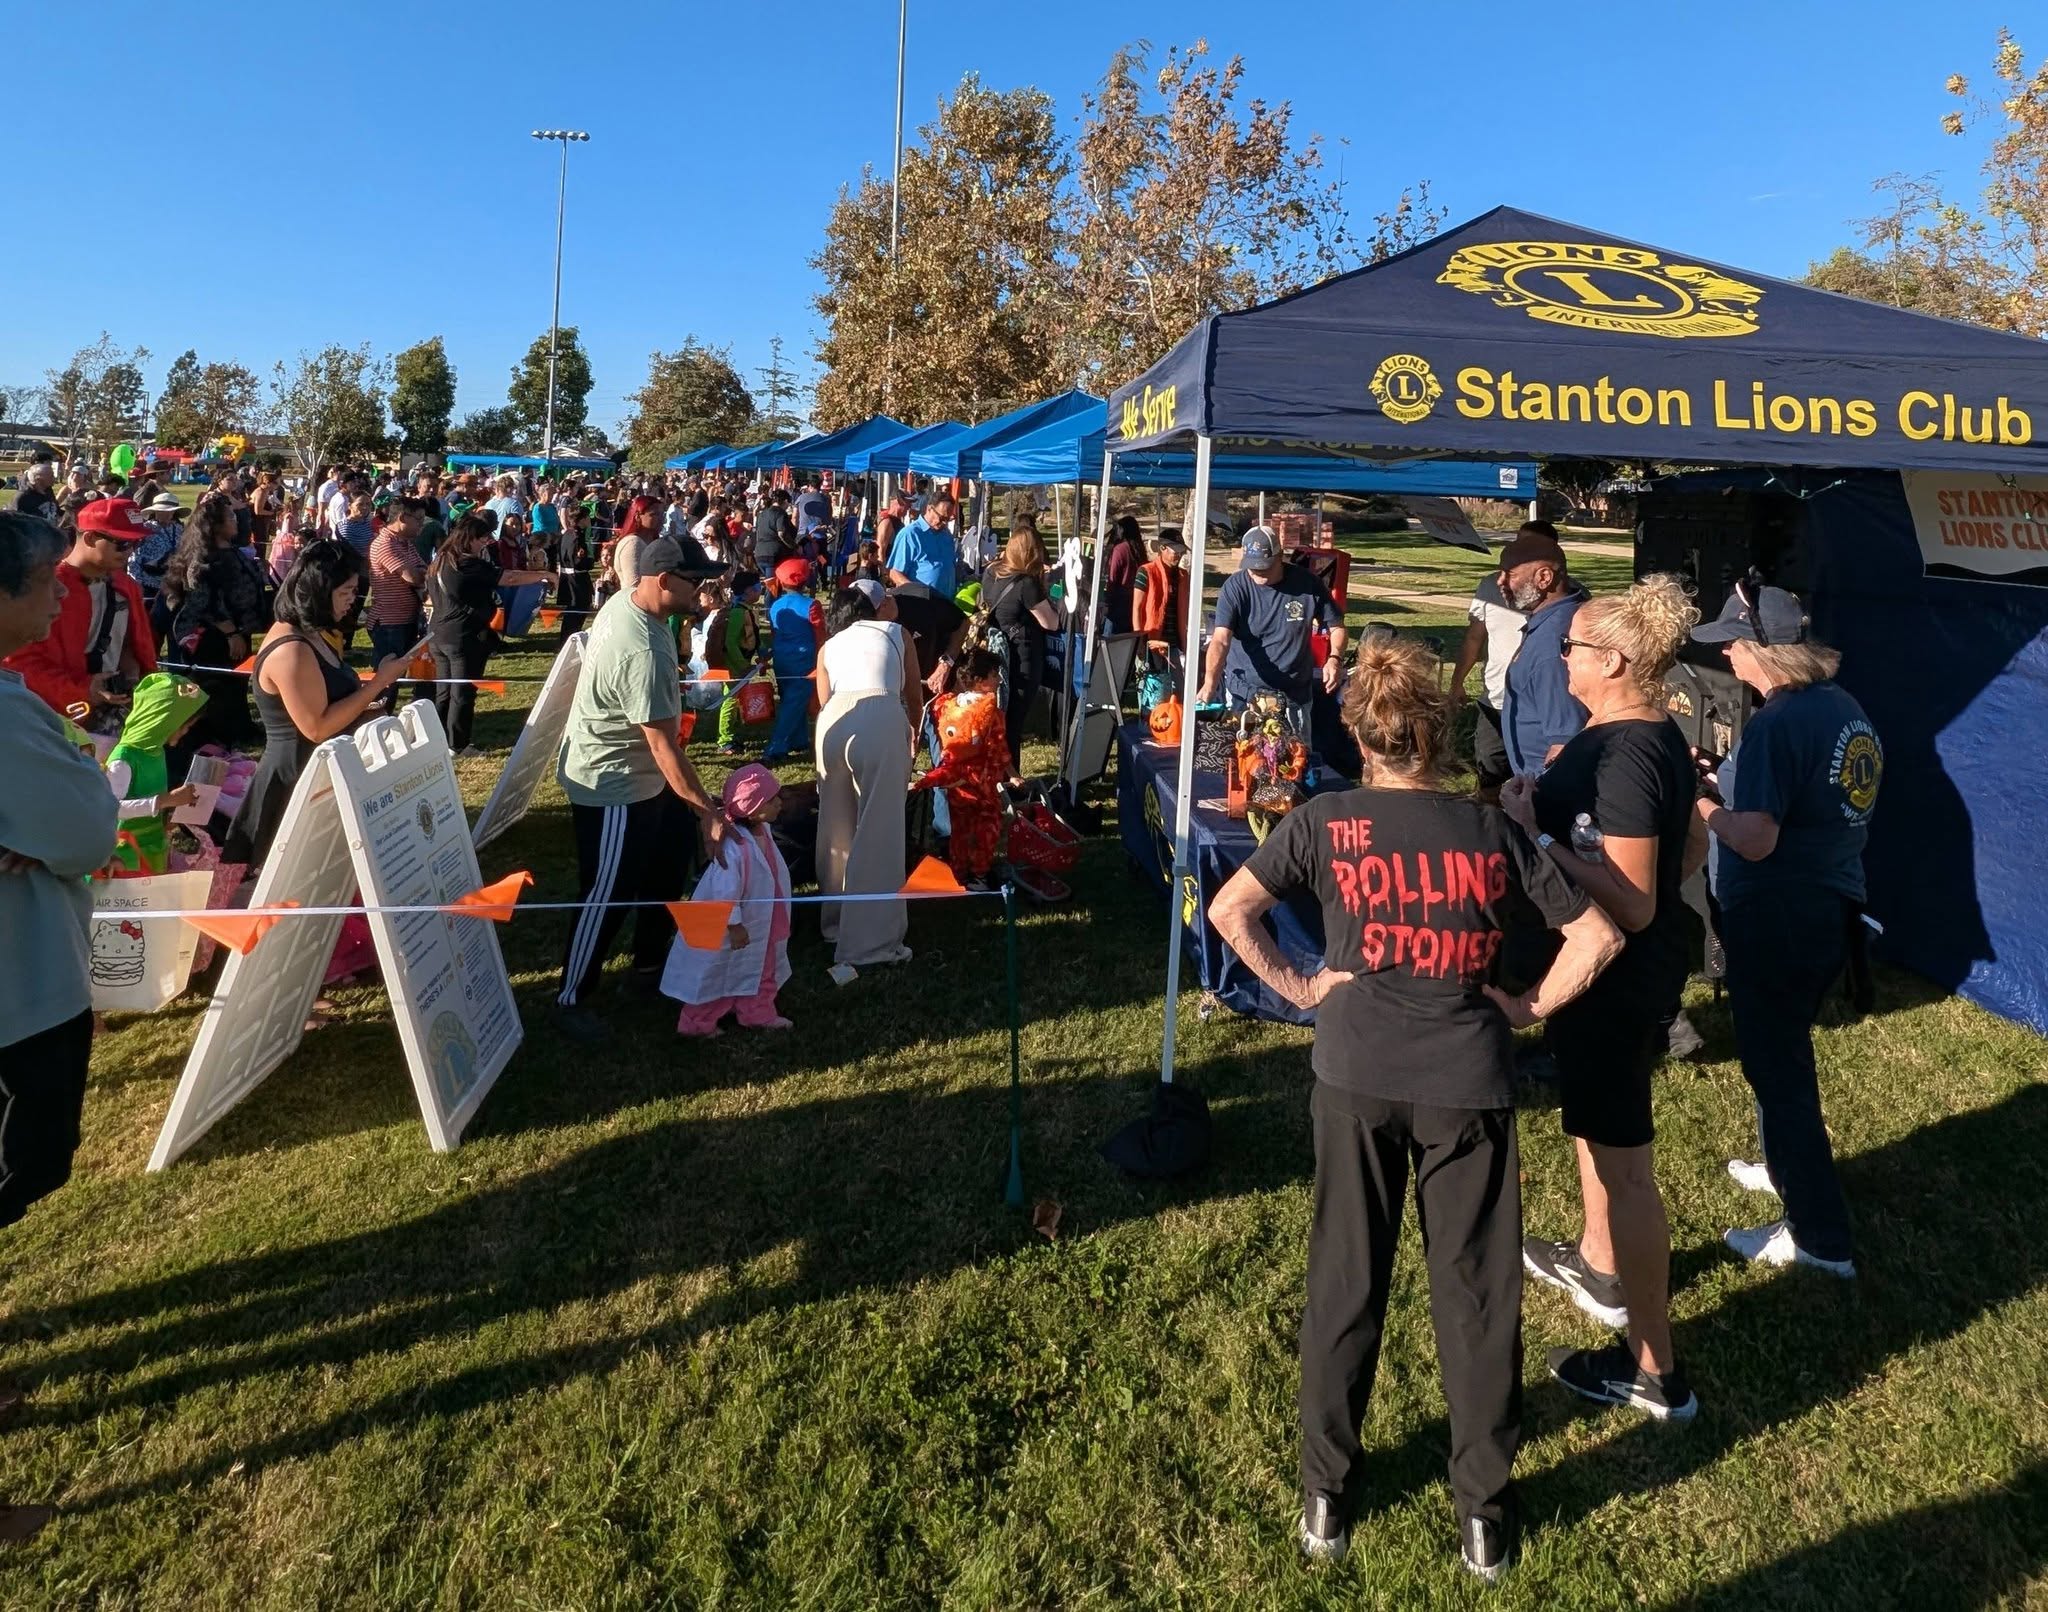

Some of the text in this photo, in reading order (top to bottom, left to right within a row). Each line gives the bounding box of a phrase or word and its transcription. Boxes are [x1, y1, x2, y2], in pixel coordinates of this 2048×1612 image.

[1475, 244, 1646, 267] LIONS
[1544, 271, 1664, 308] L
[1545, 310, 1742, 335] INTERNATIONAL
[1384, 356, 1427, 373] LIONS
[1397, 375, 1417, 400] L
[1455, 367, 2033, 446] Stanton Lions Club
[1120, 385, 1176, 441] We Serve
[1938, 521, 2009, 549] LIONS
[1829, 724, 1851, 785] STANTON
[363, 761, 444, 818] We are Stanton Lions
[1327, 817, 1372, 857] THE
[95, 897, 149, 908] AIR SPACE
[1331, 849, 1508, 923] ROLLING
[1362, 922, 1504, 985] STONES
